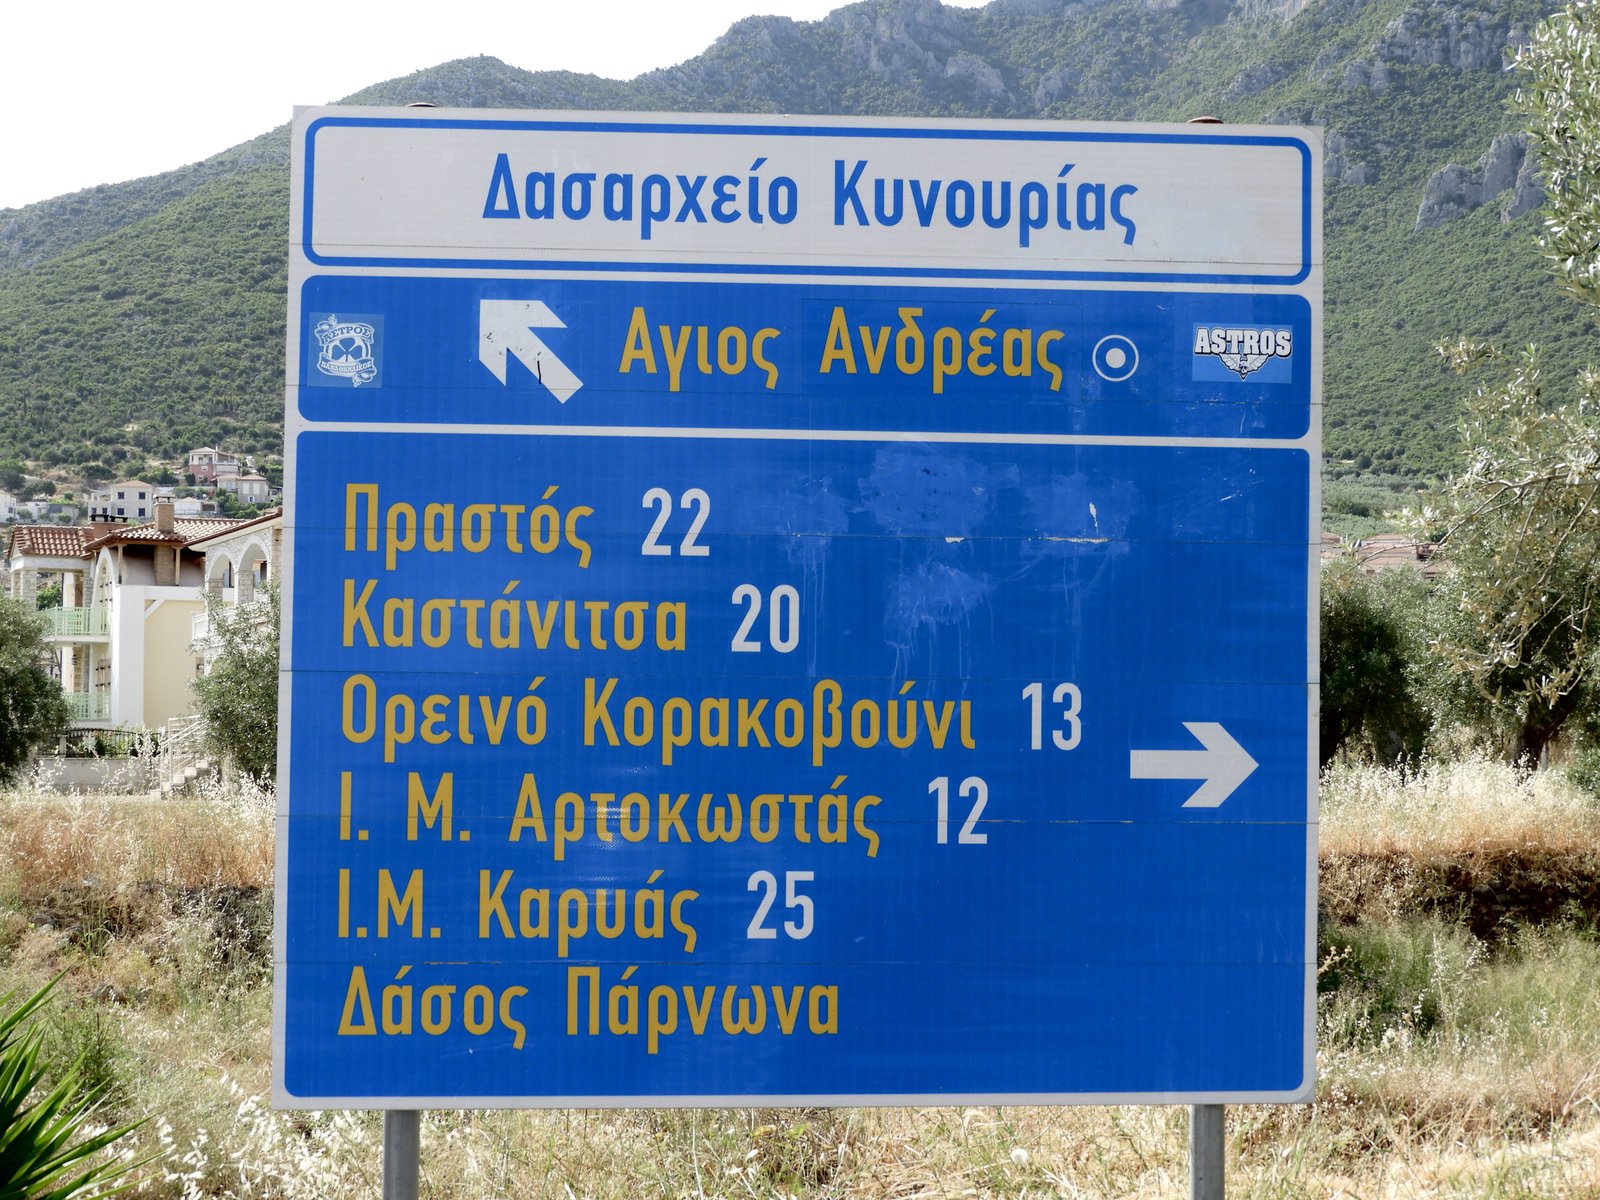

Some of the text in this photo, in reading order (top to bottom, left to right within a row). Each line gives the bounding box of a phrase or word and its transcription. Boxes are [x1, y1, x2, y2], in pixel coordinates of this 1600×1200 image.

[482, 153, 1137, 248] Δασαρχείο Κυνουρίας
[620, 308, 1063, 393] Αγιος Ανδρέας
[1194, 327, 1292, 357] ASTROS
[346, 484, 709, 569] Πραστός 22
[344, 580, 799, 652] Καστάνιτσα 20
[343, 675, 1081, 766] Ορεινό Κορακοβούνι 13
[510, 774, 880, 860] Αρτοκωστάς
[929, 777, 987, 843] 12
[480, 870, 697, 957] Καρυάς
[748, 871, 813, 938] 25
[339, 966, 837, 1053] Δάσος Πάρνωνα
